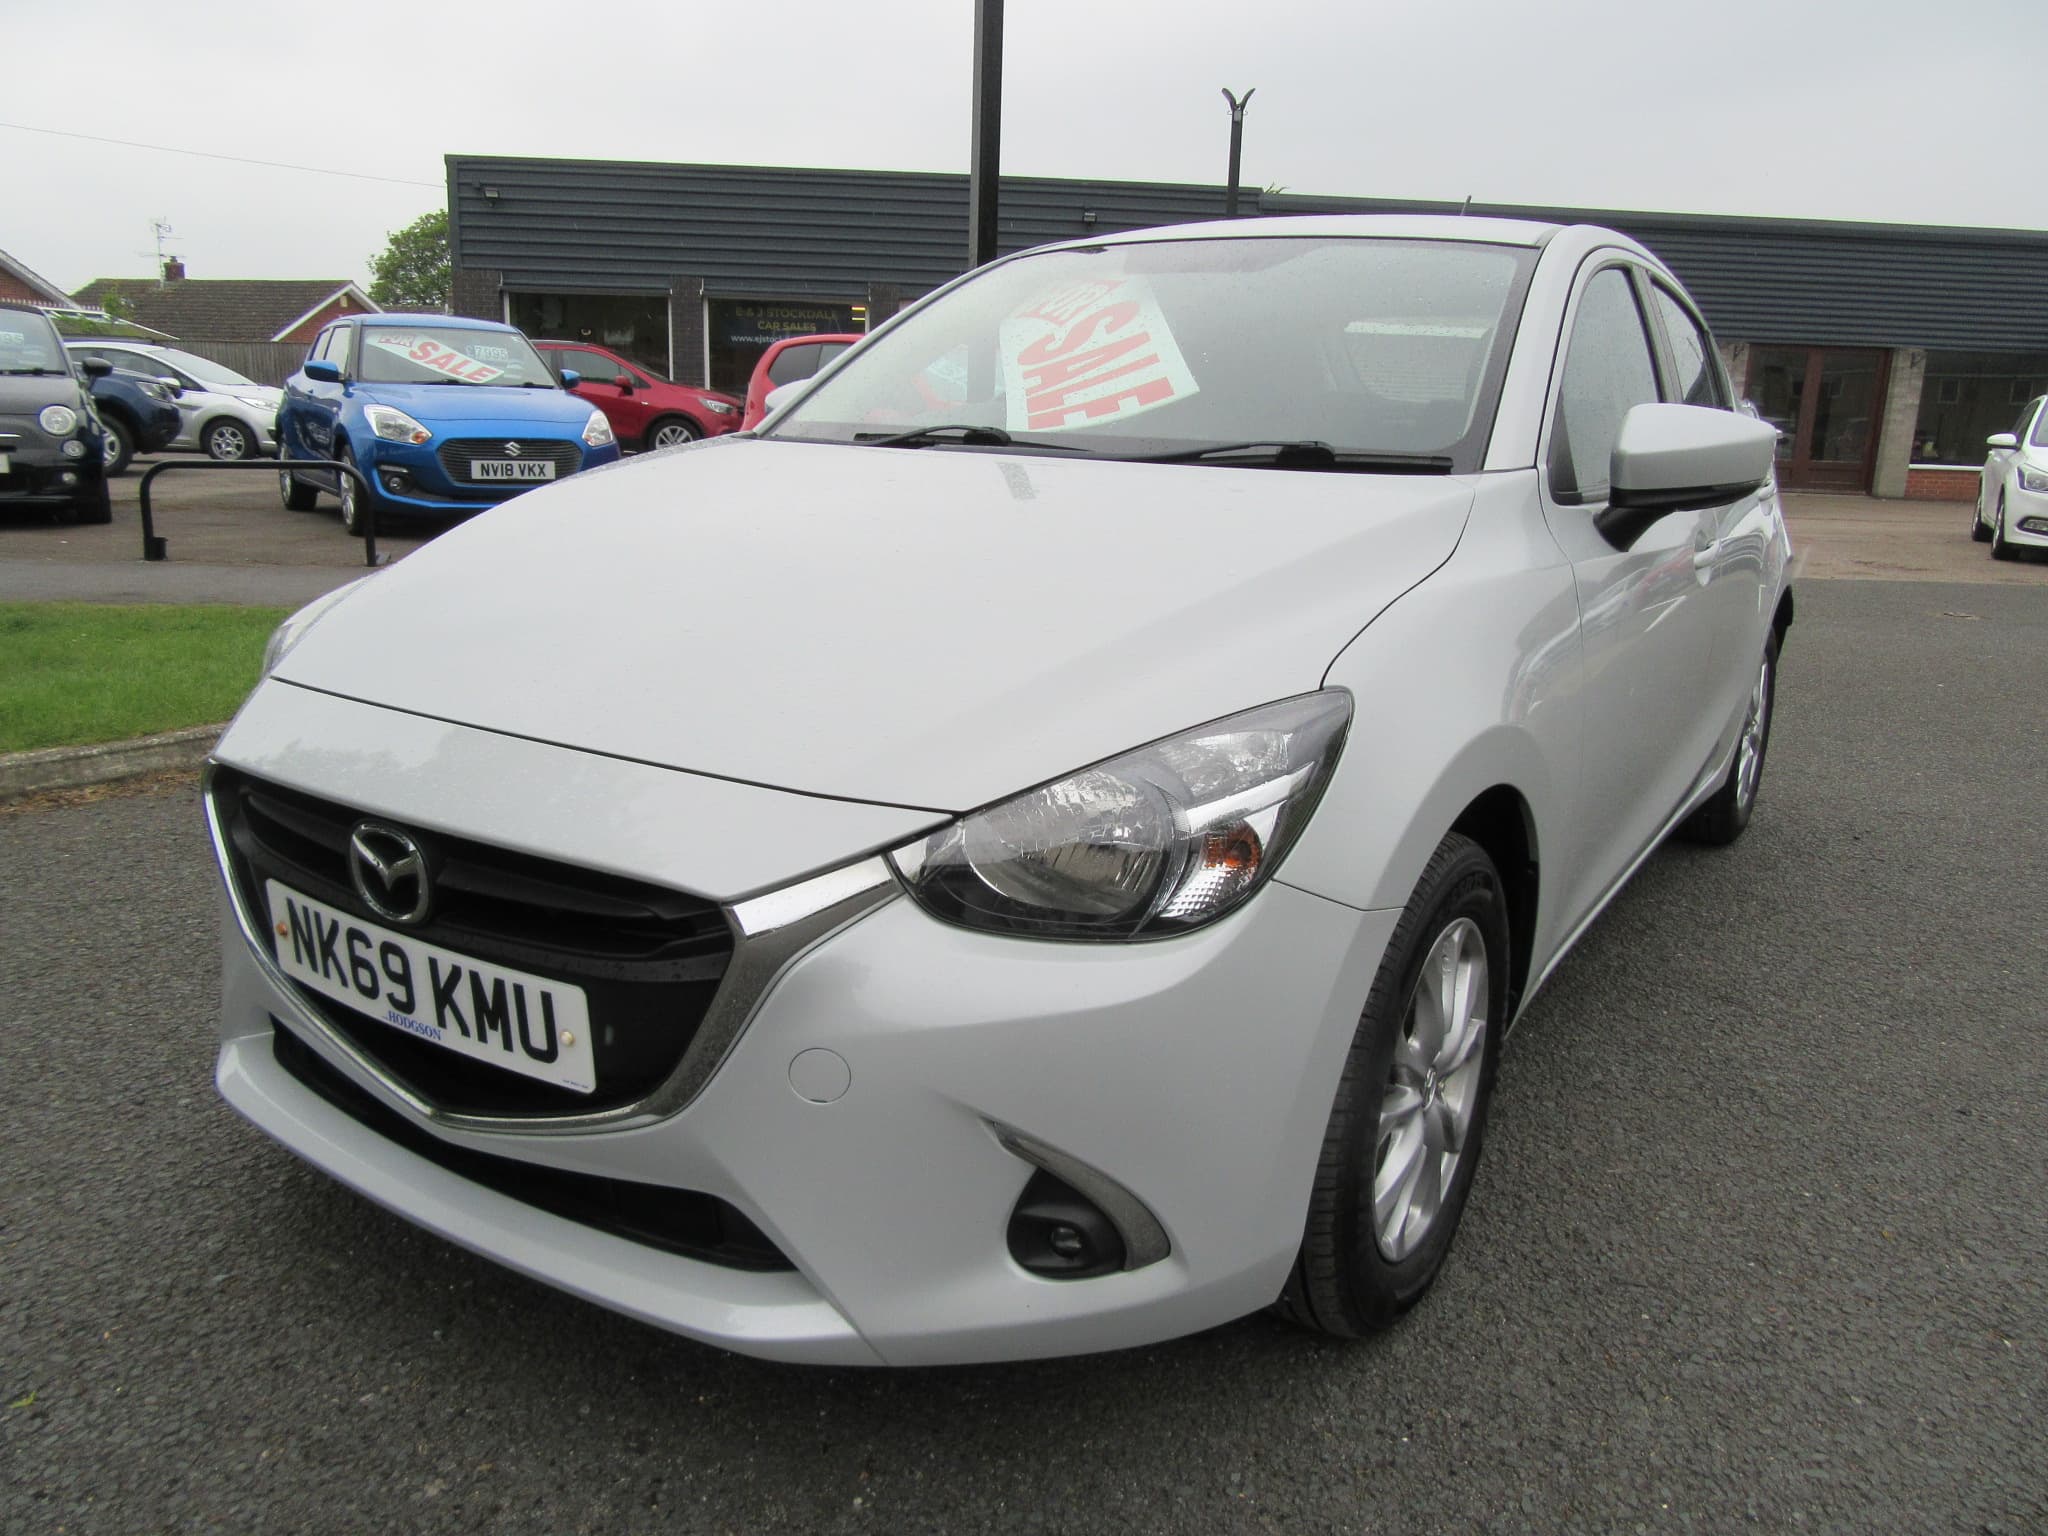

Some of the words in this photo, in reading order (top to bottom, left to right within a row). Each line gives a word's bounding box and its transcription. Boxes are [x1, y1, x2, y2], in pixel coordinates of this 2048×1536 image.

[757, 320, 781, 330] CAR
[782, 321, 817, 331] SALES
[377, 333, 415, 347] FOR
[408, 341, 497, 382] SALE
[1017, 301, 1175, 430] SALE
[480, 463, 514, 477] NV18
[518, 463, 546, 477] VKX
[286, 897, 416, 1016] NK69
[428, 956, 559, 1064] KMU
[388, 1010, 442, 1041] HODGSON
